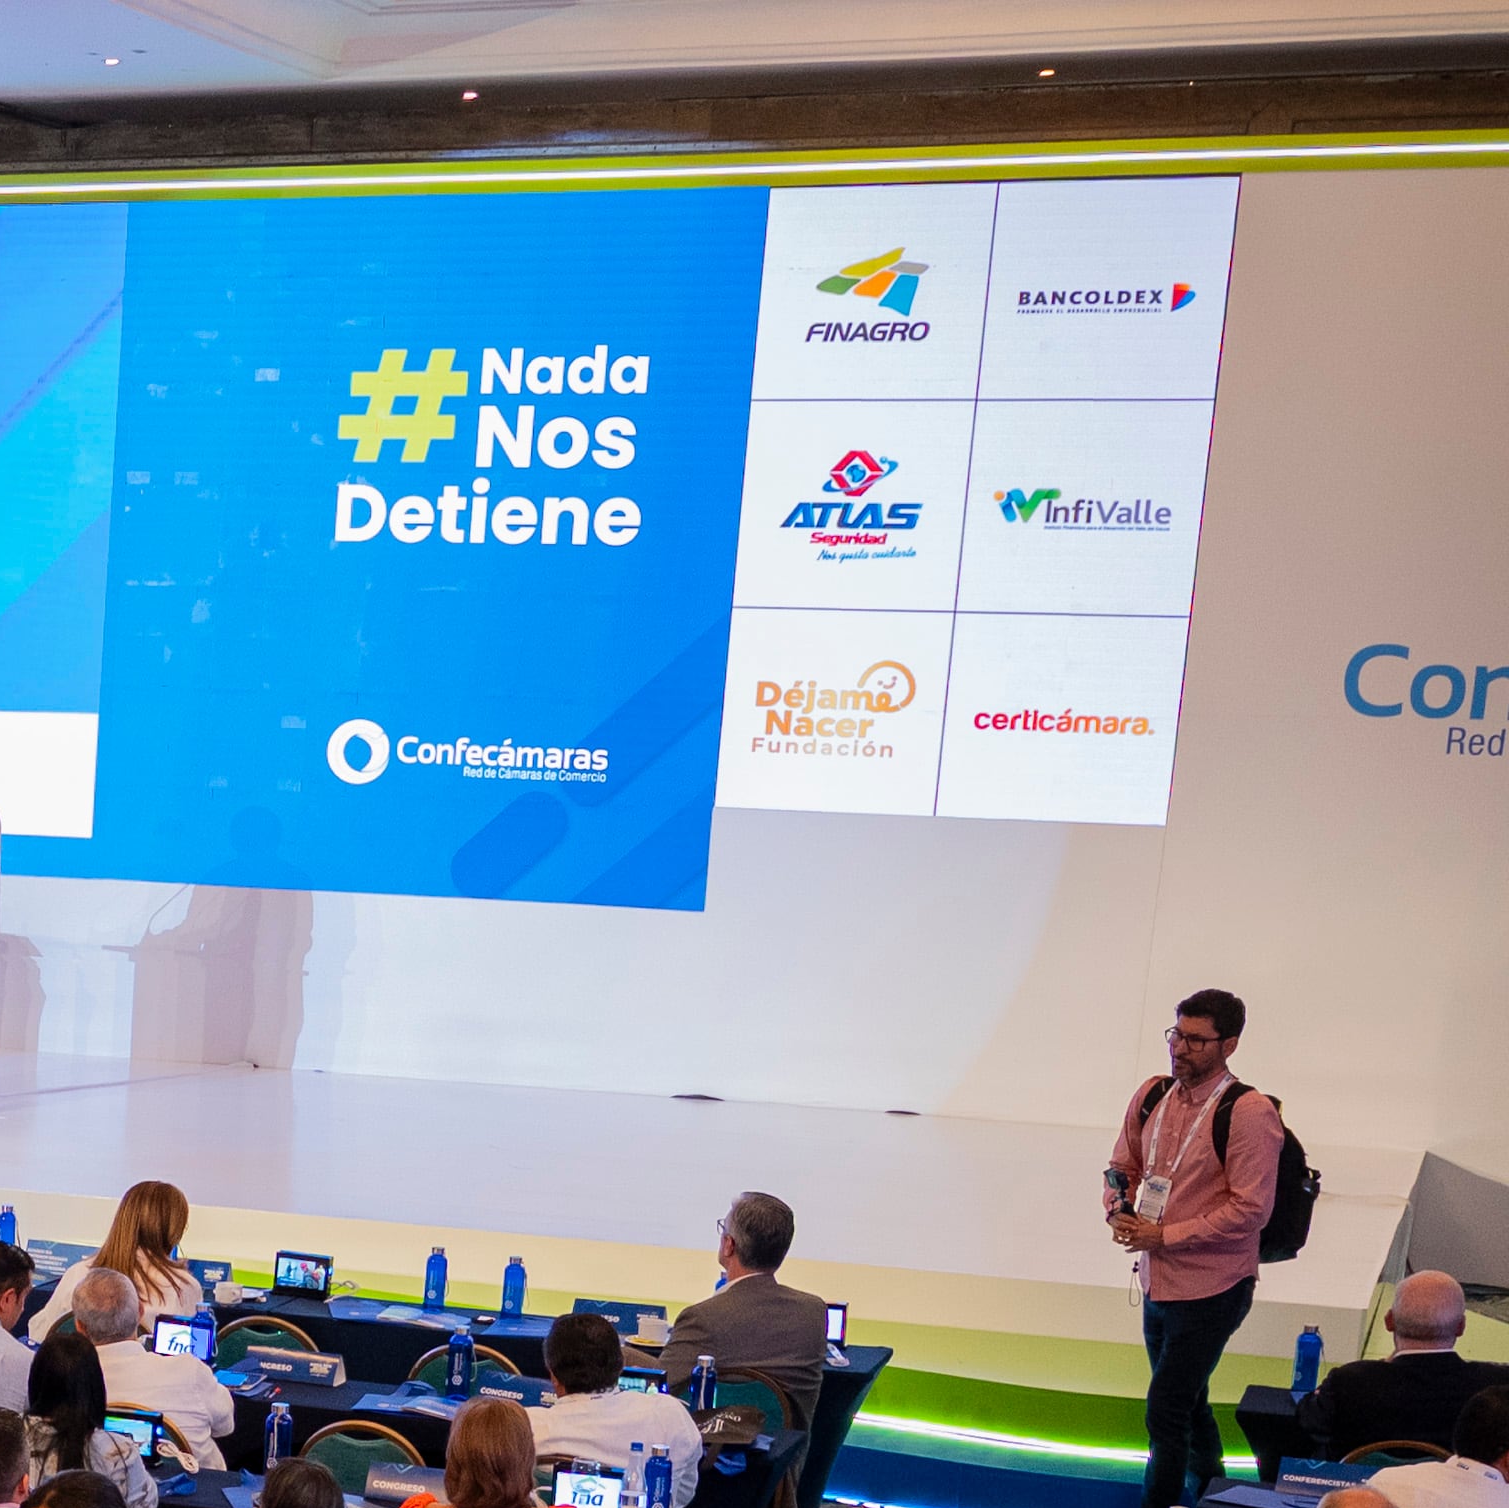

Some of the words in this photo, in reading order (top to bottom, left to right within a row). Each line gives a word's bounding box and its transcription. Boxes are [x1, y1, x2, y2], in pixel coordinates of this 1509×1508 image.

[1018, 290, 1163, 306] BANCOLDEX
[805, 322, 930, 343] FINAGRO
[480, 344, 650, 395] Nada
[476, 404, 637, 469] Nos
[334, 476, 642, 547] Detiene
[780, 502, 924, 530] ATLAS
[1045, 499, 1172, 525] InfiValle
[810, 532, 888, 546] Seguridad
[817, 549, 837, 561] Nos
[755, 680, 895, 714] Déjame
[764, 710, 874, 739] Nacer
[397, 736, 609, 771] Confecámaras
[751, 737, 894, 758] Fundación
[1446, 727, 1507, 757] Red
[463, 766, 483, 778] Red
[484, 767, 497, 779] de
[498, 768, 543, 781] Cámaras
[544, 770, 558, 781] de
[559, 770, 607, 783] Comercio
[480, 1387, 523, 1400] CONGRESO
[372, 1480, 426, 1493] CONGRESO
